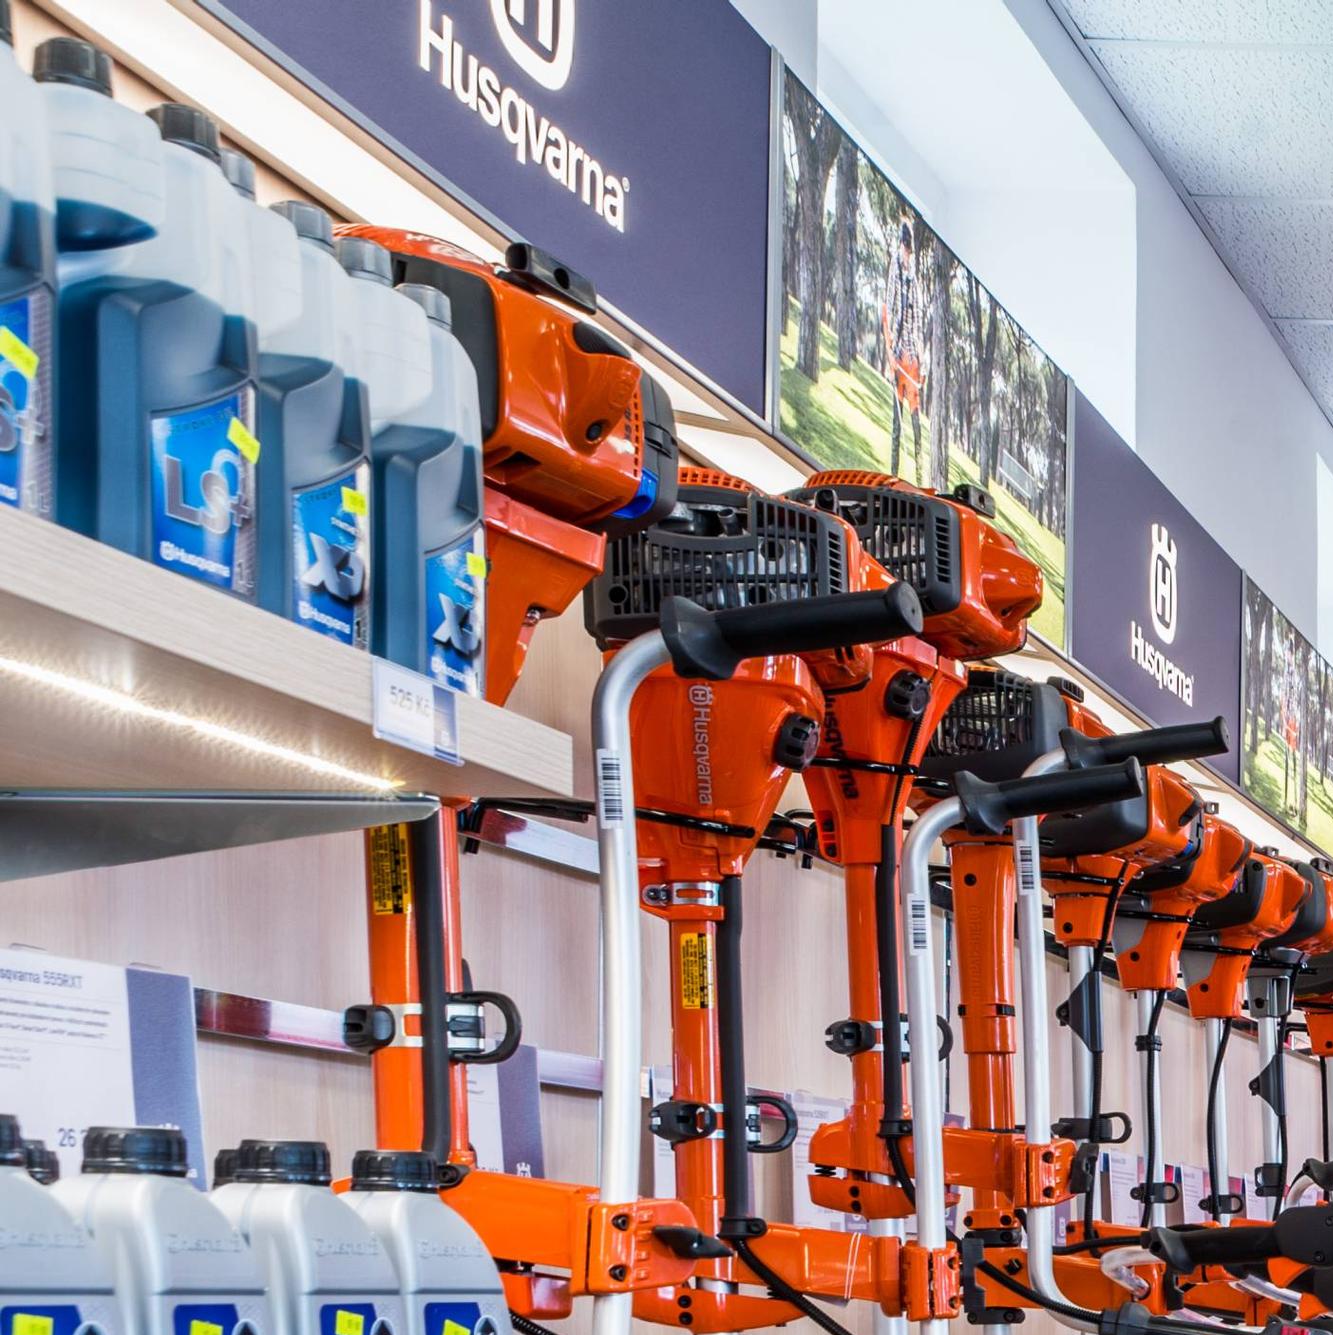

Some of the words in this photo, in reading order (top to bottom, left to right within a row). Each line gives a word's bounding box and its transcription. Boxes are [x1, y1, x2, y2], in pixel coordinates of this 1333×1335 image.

[420, 0, 631, 233] Husqvarna
[1131, 621, 1194, 707] Husqvarna
[693, 705, 713, 806] Husqvarna
[0, 967, 41, 985] sqvarna
